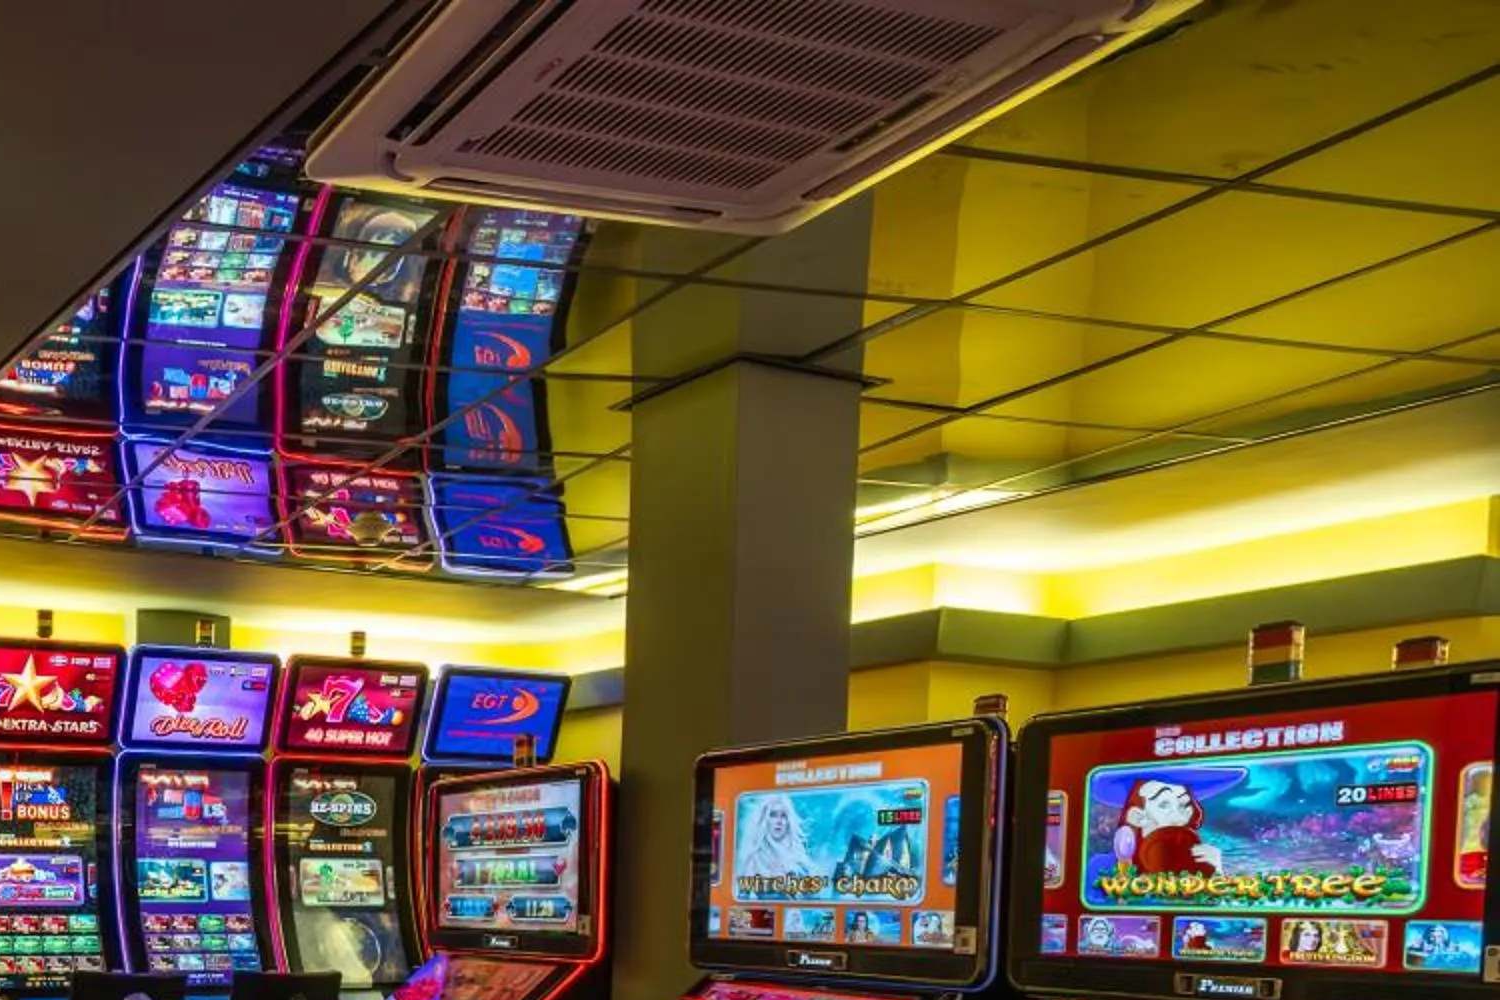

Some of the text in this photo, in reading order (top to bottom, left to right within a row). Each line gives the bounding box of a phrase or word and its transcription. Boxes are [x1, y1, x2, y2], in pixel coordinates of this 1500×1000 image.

[471, 692, 507, 710] EGT
[3, 717, 48, 732] EXTRA
[50, 719, 98, 733] STARS
[324, 728, 365, 745] SUPER
[365, 731, 393, 746] HOT
[1154, 720, 1345, 756] COLLECTION
[1337, 784, 1417, 803] 20 LINES
[17, 805, 71, 820] BONUS
